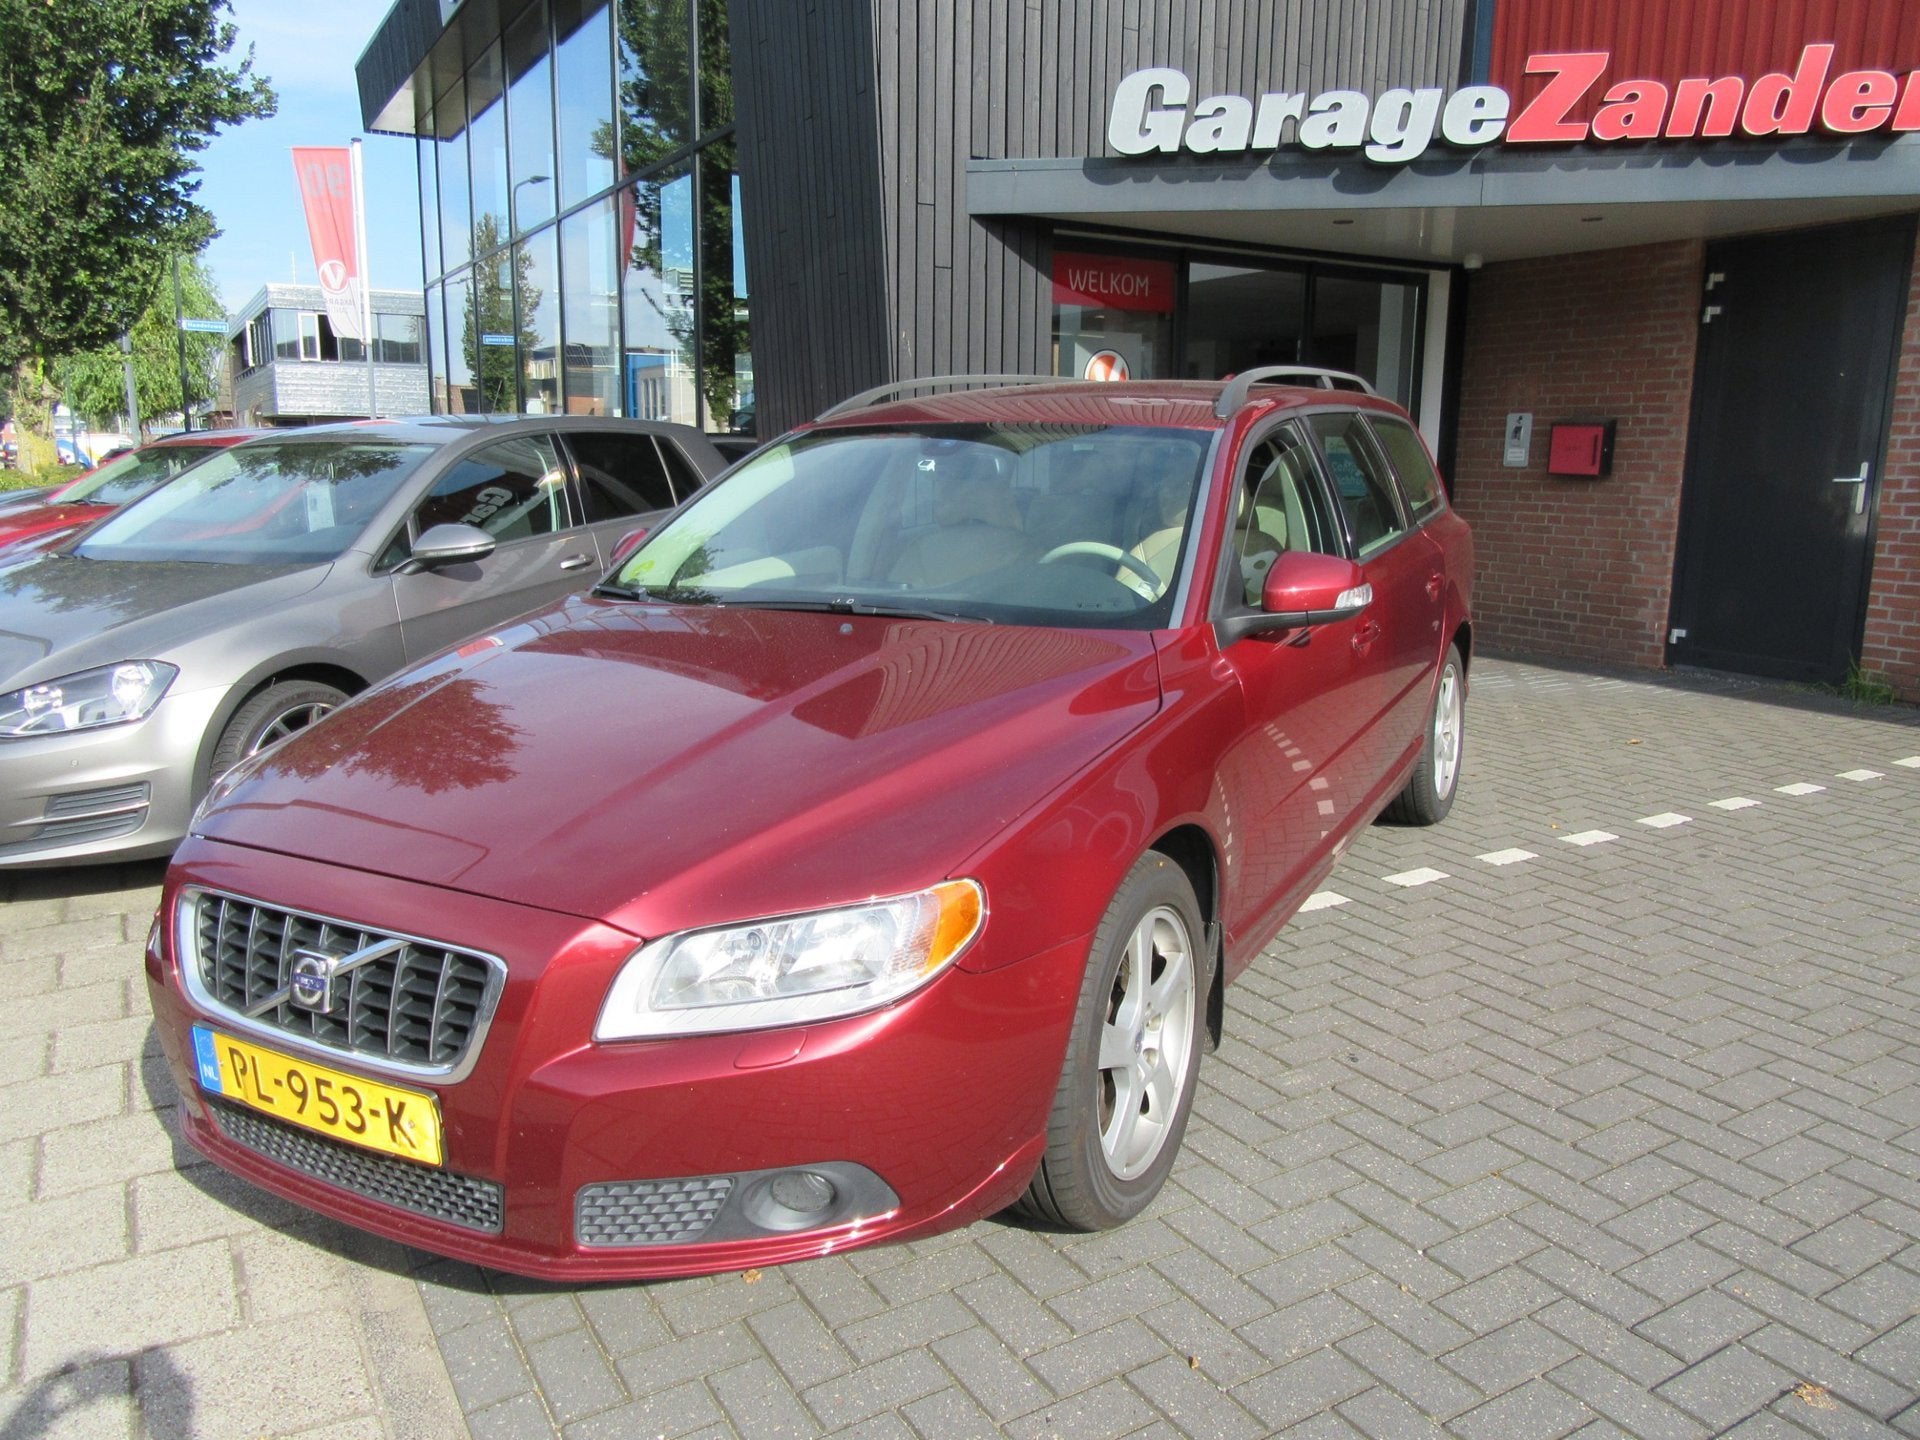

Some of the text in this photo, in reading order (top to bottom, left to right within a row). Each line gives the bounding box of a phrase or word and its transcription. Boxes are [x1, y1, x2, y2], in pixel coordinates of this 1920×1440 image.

[1108, 67, 1510, 163] Garage
[1068, 269, 1149, 297] WELKOM
[203, 1063, 219, 1081] NL
[228, 1046, 417, 1149] PL-953-K
